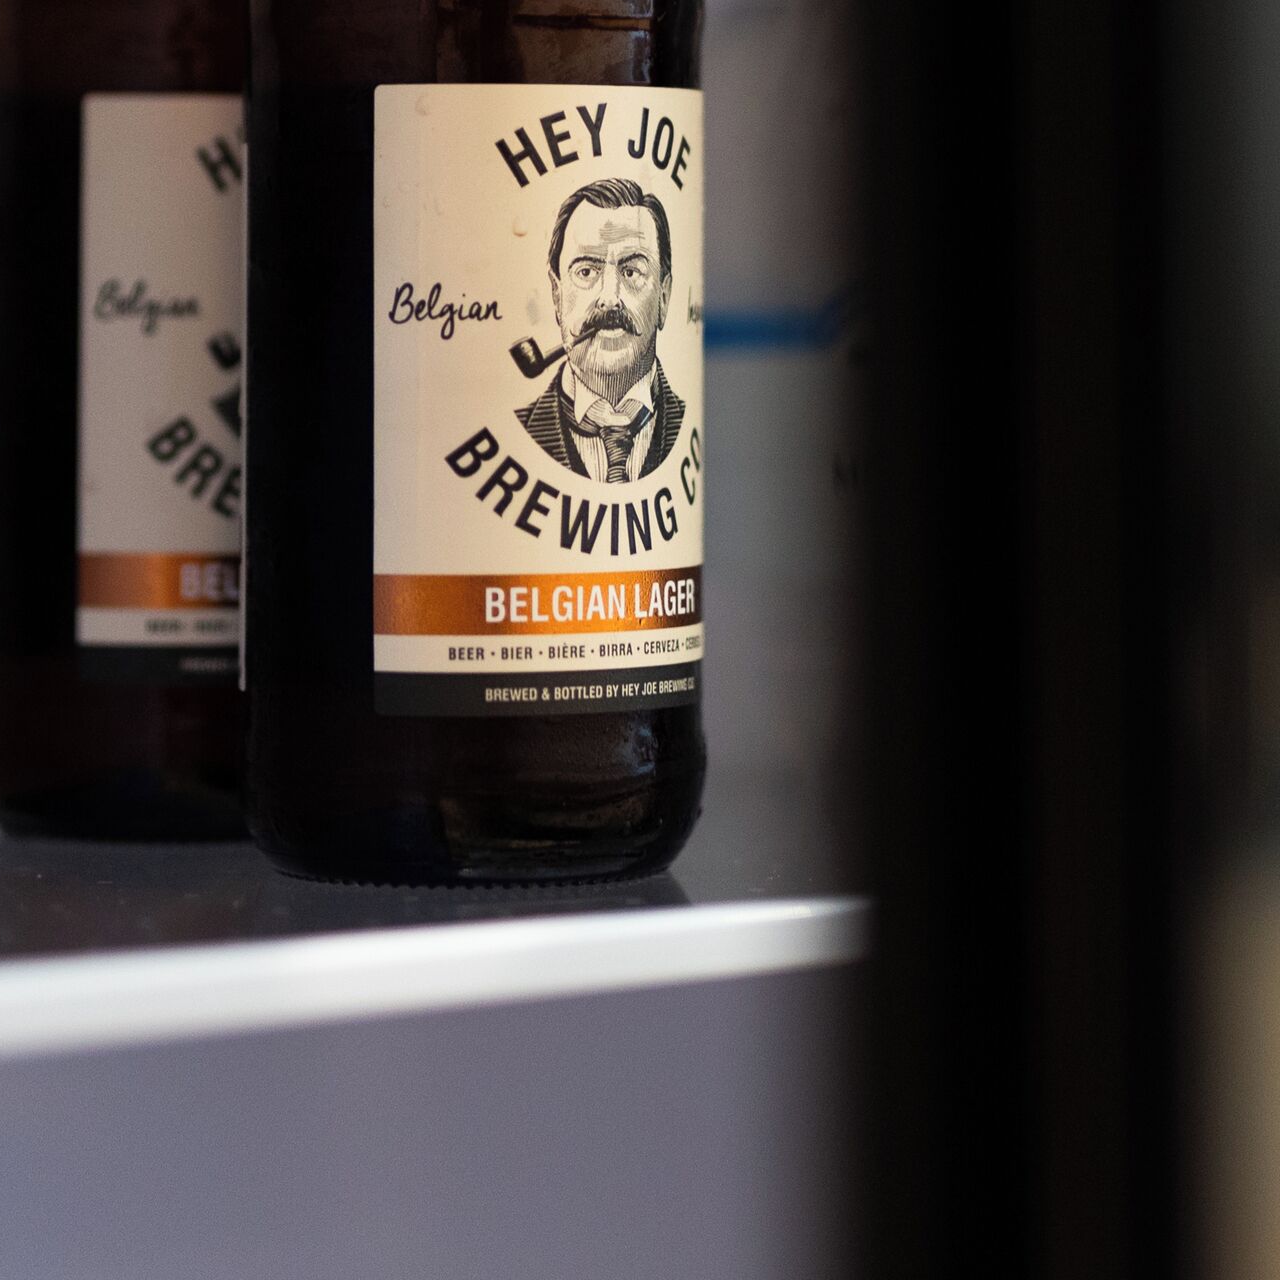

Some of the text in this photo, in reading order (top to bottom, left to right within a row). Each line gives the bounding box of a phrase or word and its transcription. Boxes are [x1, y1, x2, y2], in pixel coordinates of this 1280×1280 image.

[495, 102, 691, 190] HEY JOE
[388, 282, 503, 340] Belgian
[444, 426, 679, 556] BREWING
[484, 577, 696, 624] BELGIAN LAGER
[448, 646, 485, 661] BEER
[501, 646, 533, 661] BIER
[548, 642, 586, 660] BIÈRE
[599, 643, 633, 658] BIRRA
[644, 638, 680, 655] CERVEZA
[485, 686, 538, 702] BREWED
[541, 686, 550, 701] &
[554, 684, 603, 701] BOTTLED
[606, 683, 619, 698] BY
[621, 682, 640, 697] HEY
[641, 680, 658, 696] JOE
